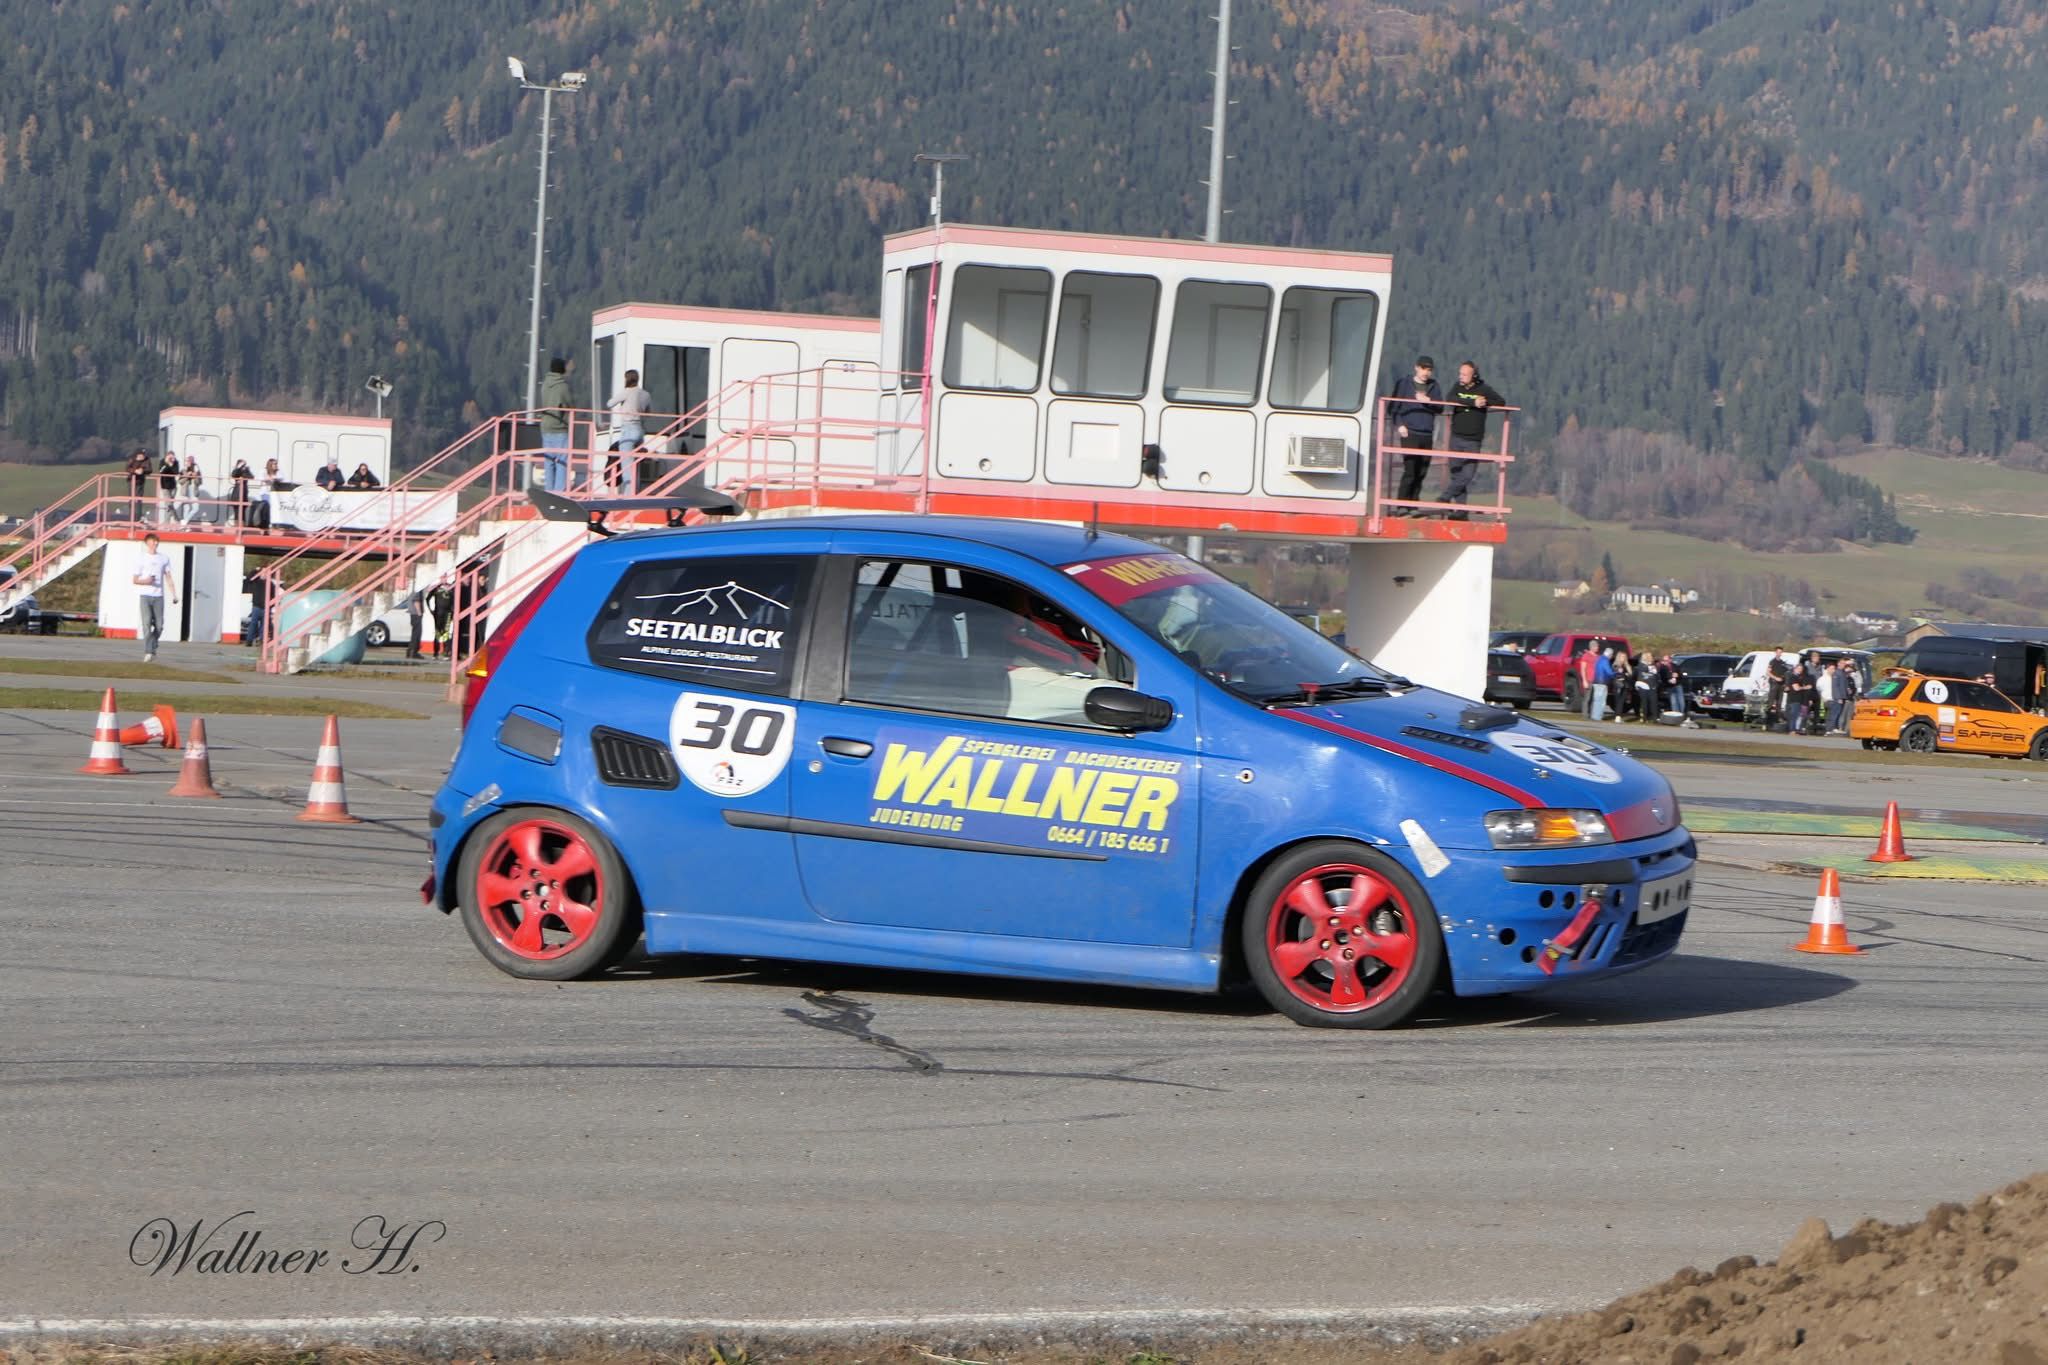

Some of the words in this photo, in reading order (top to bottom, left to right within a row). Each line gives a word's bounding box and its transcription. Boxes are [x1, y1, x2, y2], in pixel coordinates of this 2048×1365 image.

[626, 618, 784, 649] SEETALBLICK
[641, 645, 671, 655] ALPINE
[671, 648, 700, 658] LODGE
[705, 651, 759, 663] RESTAURANT
[1931, 687, 1941, 696] 11
[680, 701, 785, 757] 30
[1957, 729, 2025, 742] SAPPER
[964, 740, 1057, 761] SPENGLEREI
[1064, 751, 1182, 775] DACHDECKEREI
[1511, 744, 1599, 765] 30
[873, 736, 1180, 831] WALLNER
[869, 807, 965, 832] JUDENBURG
[1047, 825, 1086, 844] 0664
[1099, 831, 1128, 849] 185
[1128, 835, 1158, 853] 666
[1159, 838, 1171, 854] 1
